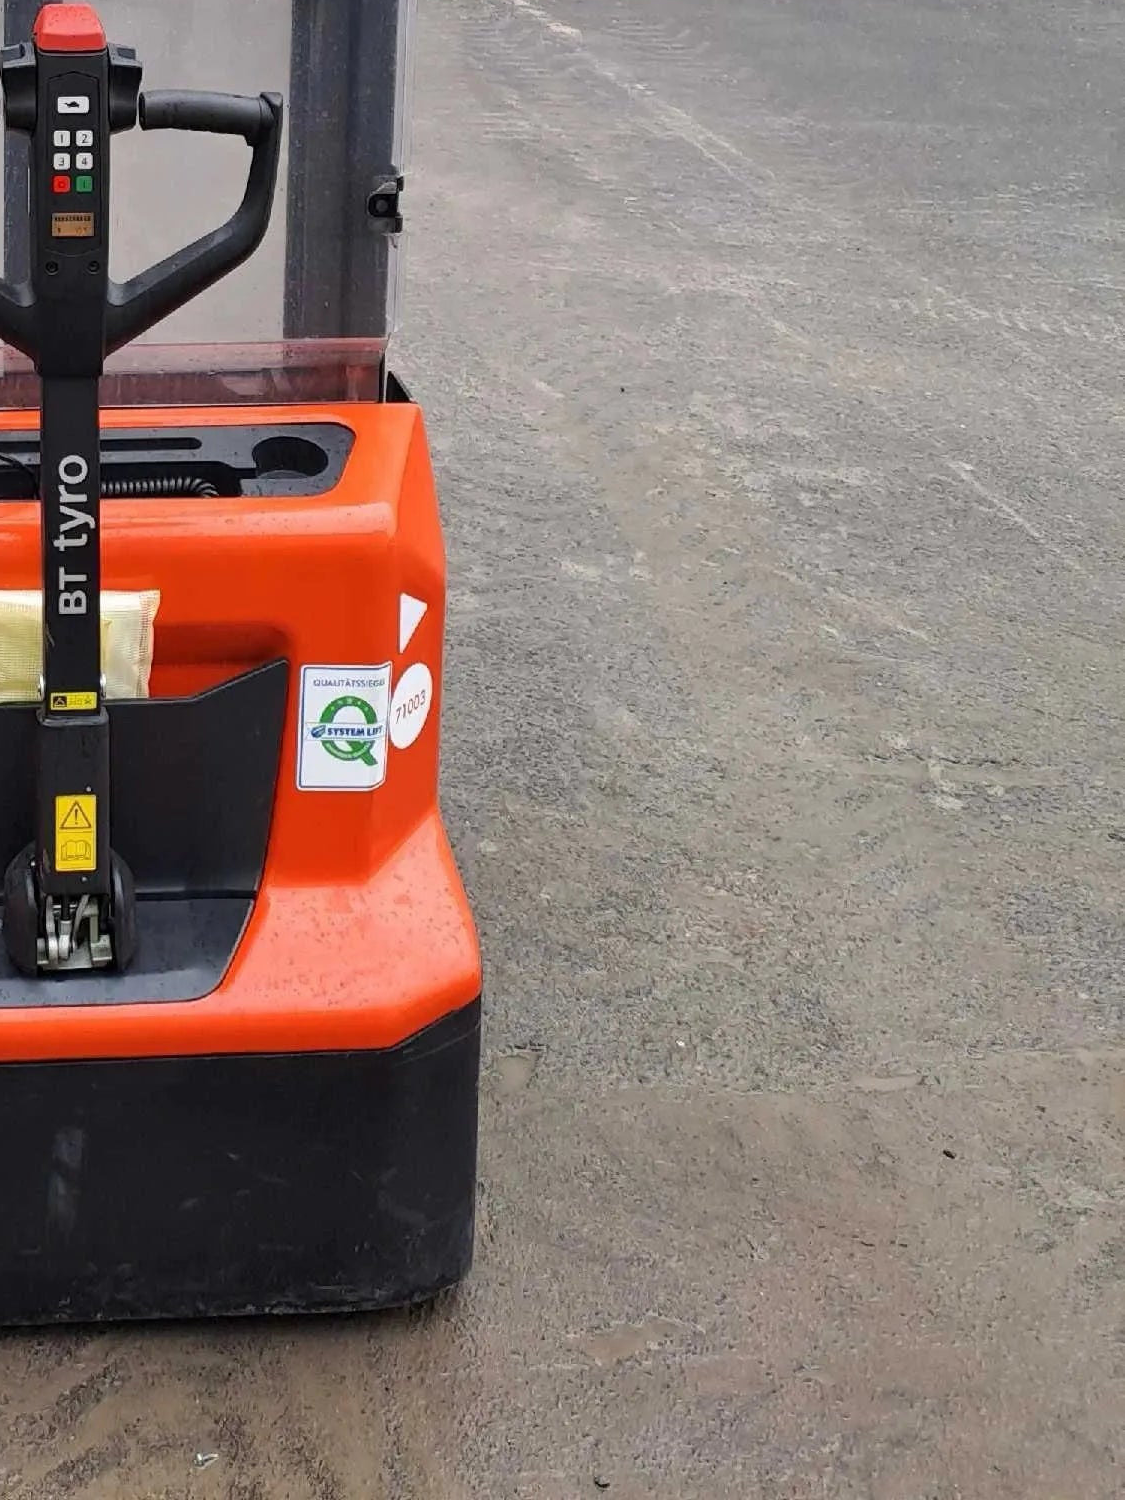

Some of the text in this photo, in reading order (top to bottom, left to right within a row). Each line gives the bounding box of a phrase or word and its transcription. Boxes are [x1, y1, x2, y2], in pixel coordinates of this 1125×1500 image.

[81, 134, 89, 144] 2
[58, 157, 65, 166] 3
[81, 157, 88, 166] 4
[52, 454, 96, 615] BT tyro
[395, 690, 426, 724] 71003
[327, 728, 365, 737] SYSTEM
